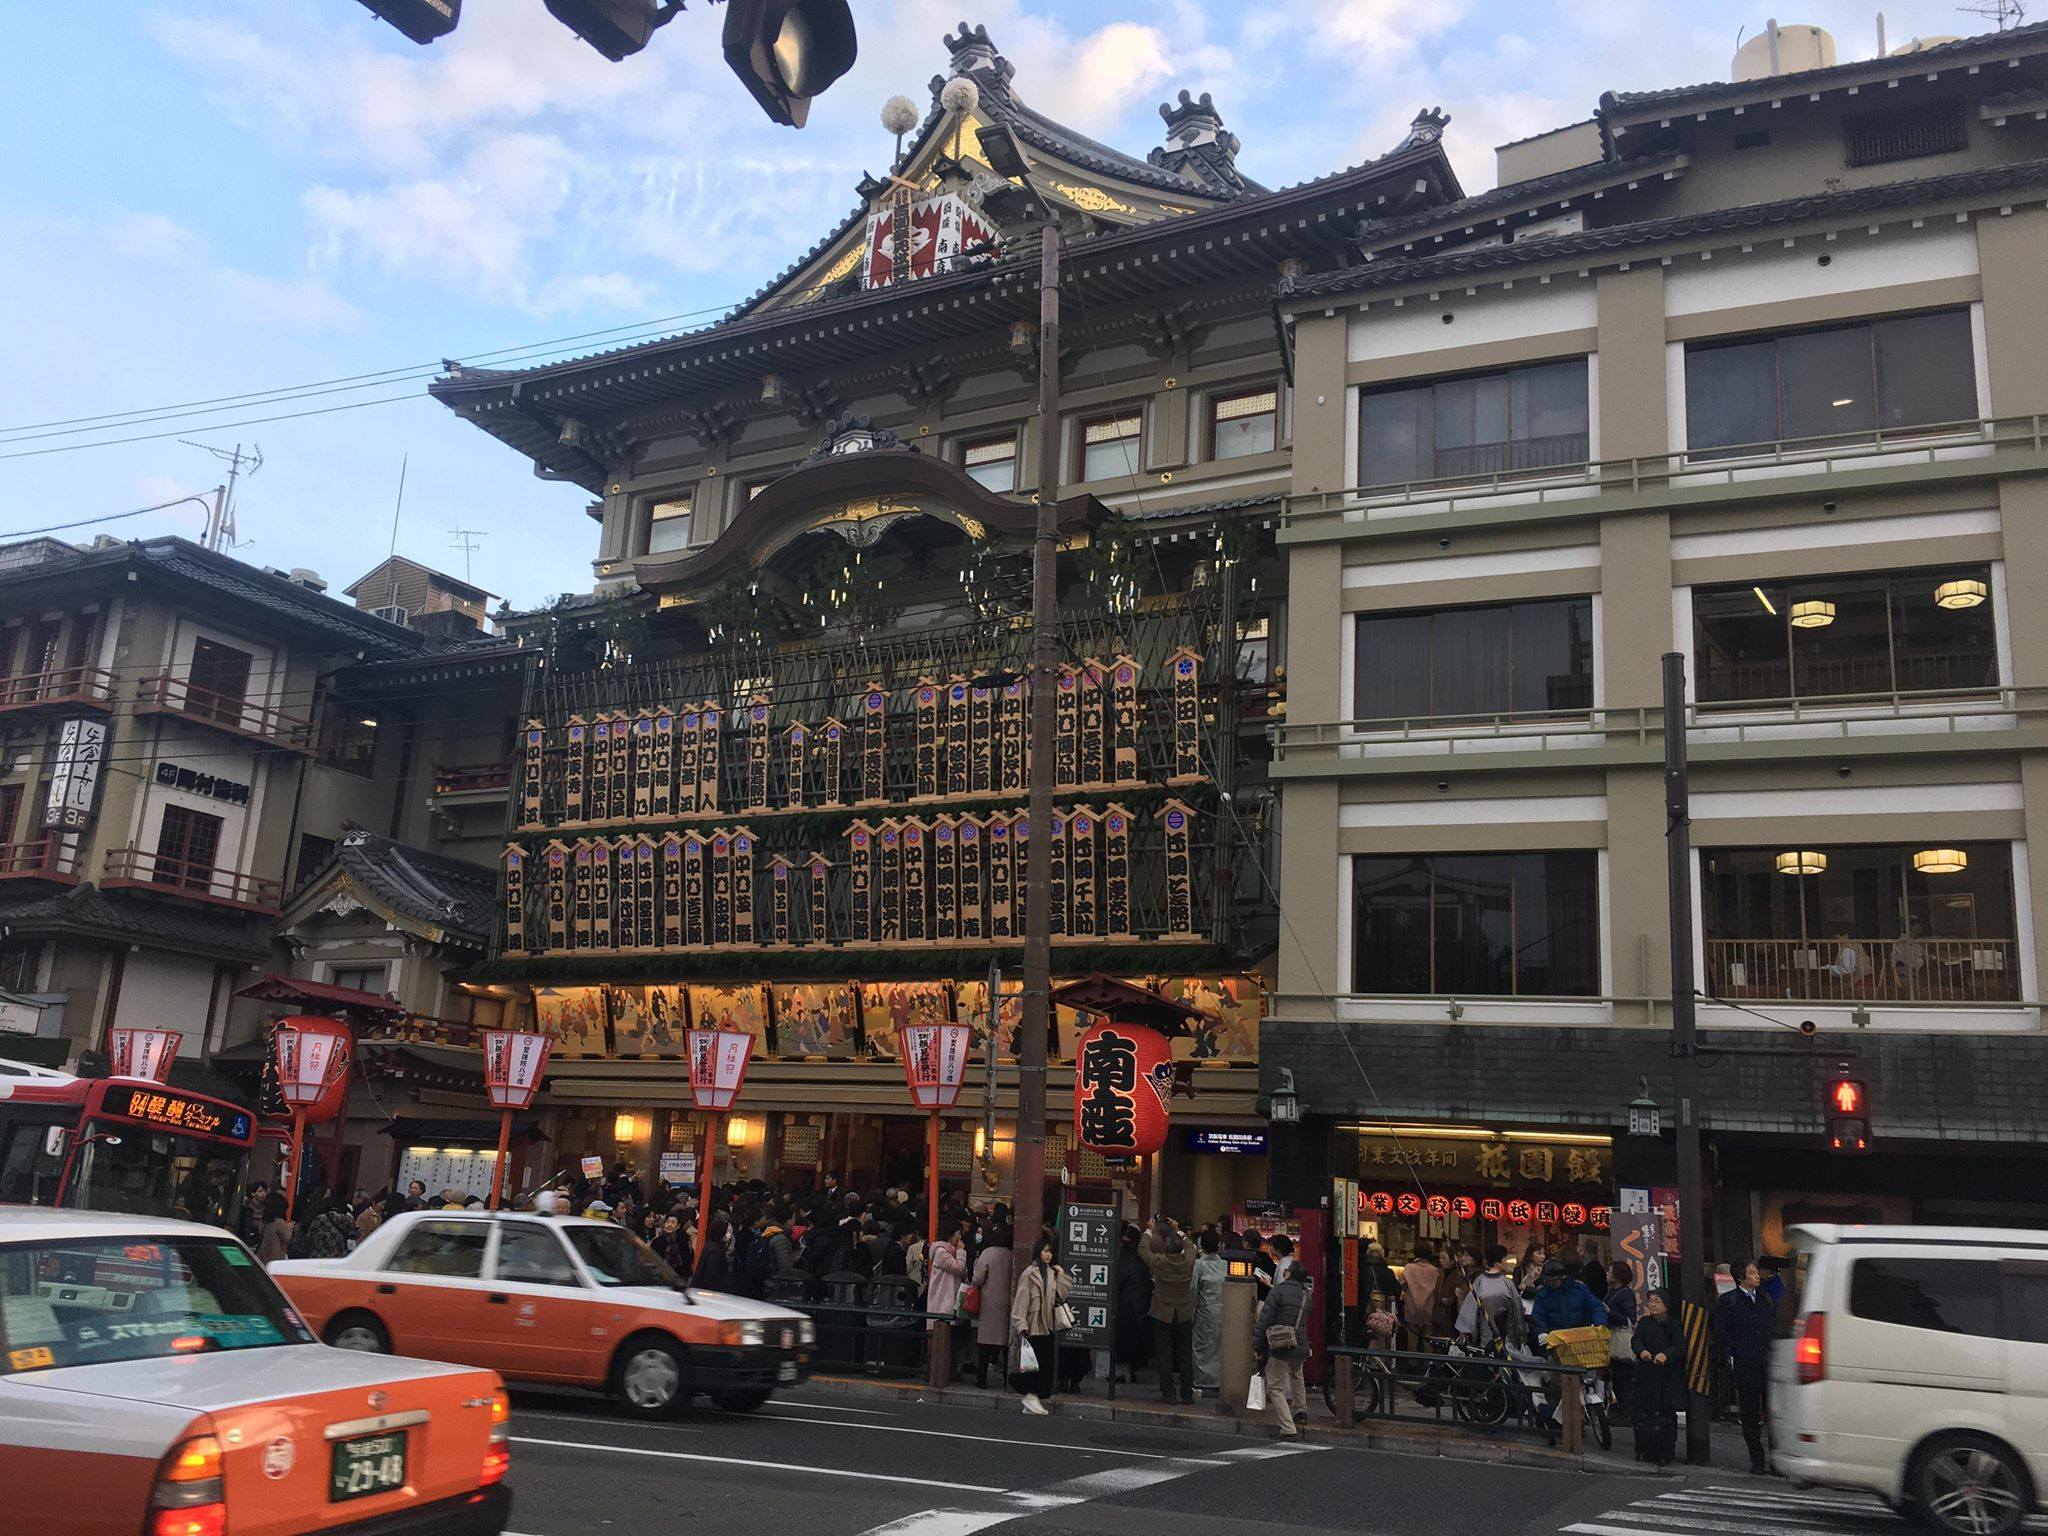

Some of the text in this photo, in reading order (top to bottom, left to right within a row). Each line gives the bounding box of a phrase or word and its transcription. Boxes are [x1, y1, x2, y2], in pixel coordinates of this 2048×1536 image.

[1177, 679, 1197, 775] 坂田藤十郎
[161, 768, 176, 779] 4F
[702, 728, 717, 810] 中村隼人
[65, 808, 85, 826] 3F
[1167, 832, 1189, 932] 片岡仁左衛門
[725, 1043, 738, 1075] 月桂冠
[1081, 1030, 1138, 1147] 南座
[149, 1096, 185, 1118] 醍醐
[187, 1103, 204, 1114] バス
[184, 1112, 220, 1127] ターミナル
